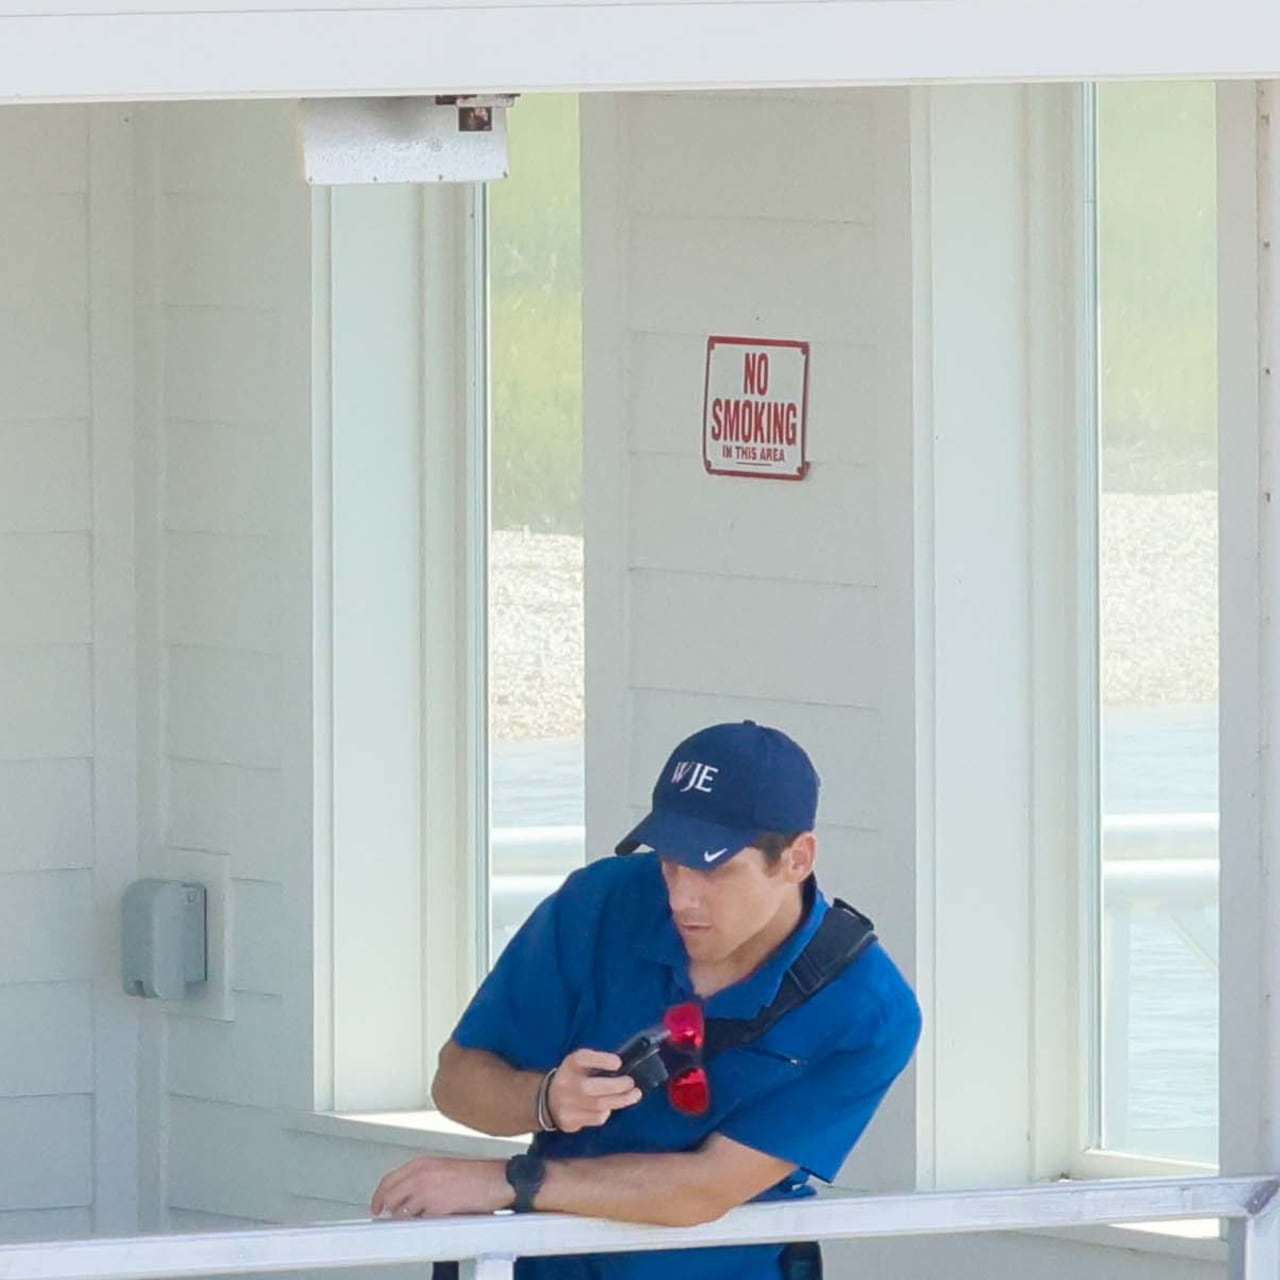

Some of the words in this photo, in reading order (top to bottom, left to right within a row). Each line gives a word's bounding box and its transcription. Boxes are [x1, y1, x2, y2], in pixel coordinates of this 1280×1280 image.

[743, 352, 768, 396] NO
[711, 398, 797, 446] SMOKING
[722, 445, 732, 459] IN
[735, 446, 757, 460] THIS
[760, 447, 785, 462] AREA
